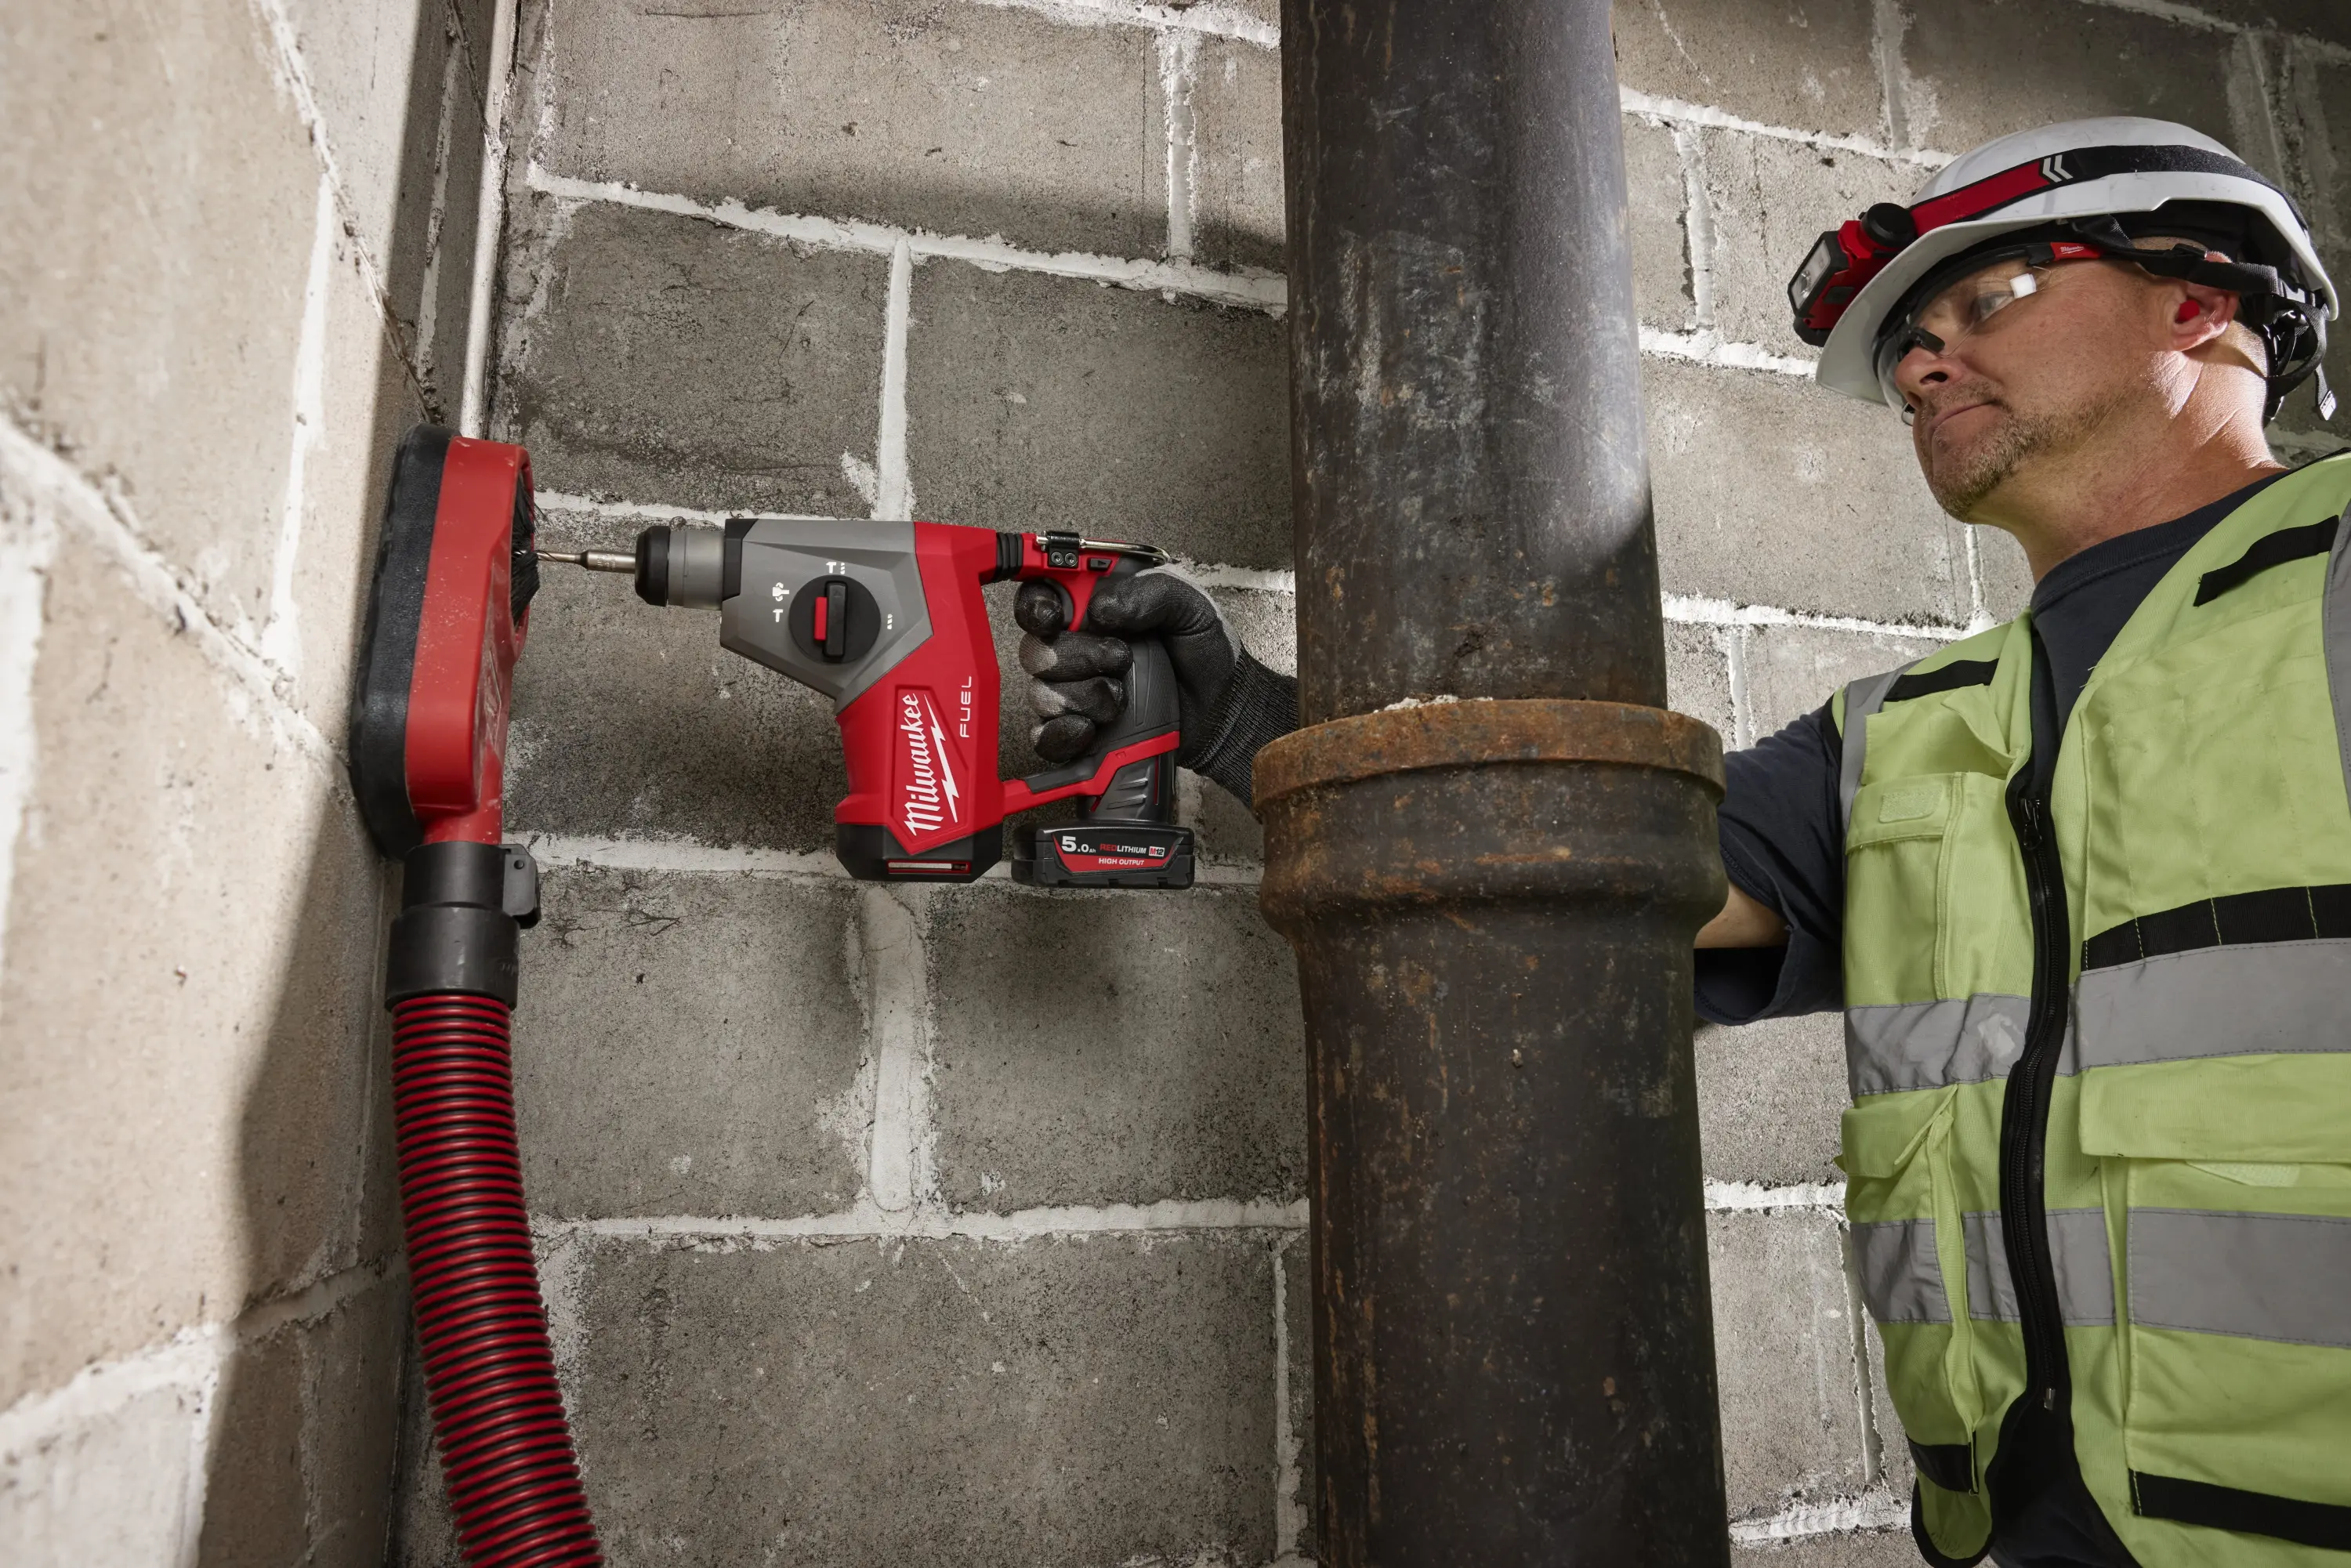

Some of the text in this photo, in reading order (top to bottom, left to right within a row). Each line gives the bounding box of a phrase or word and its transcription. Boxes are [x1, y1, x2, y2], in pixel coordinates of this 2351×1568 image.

[959, 675, 972, 738] FUEL
[900, 693, 944, 836] Milwaukee
[1099, 843, 1147, 854] REDLITHIUM
[1150, 846, 1165, 856] M12
